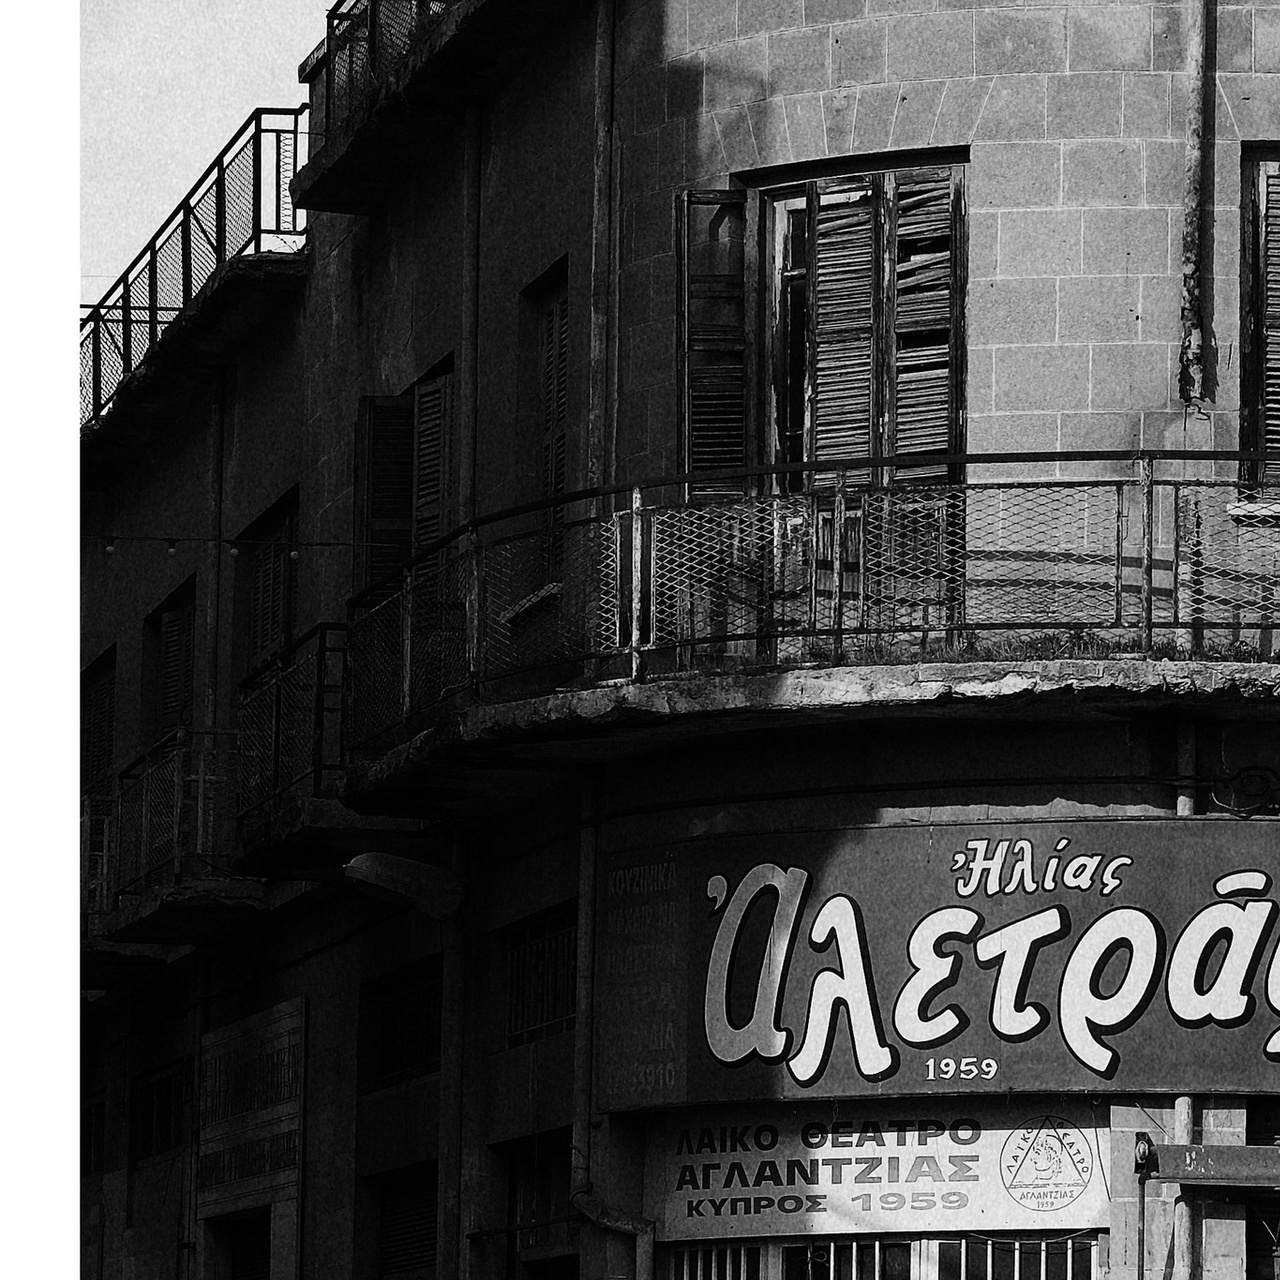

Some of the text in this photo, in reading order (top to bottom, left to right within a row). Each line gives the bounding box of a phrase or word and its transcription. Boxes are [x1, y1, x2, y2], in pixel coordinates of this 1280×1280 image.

[925, 1057, 999, 1080] 1959
[675, 1118, 982, 1156] ΛΑΙΚΟ ΘΕΑΤΡΟ
[675, 1154, 980, 1192] ΑΓΛΑΝΤΖΙΑΣ
[686, 1191, 970, 1218] ΚΥΠΡΟΣ 1959
